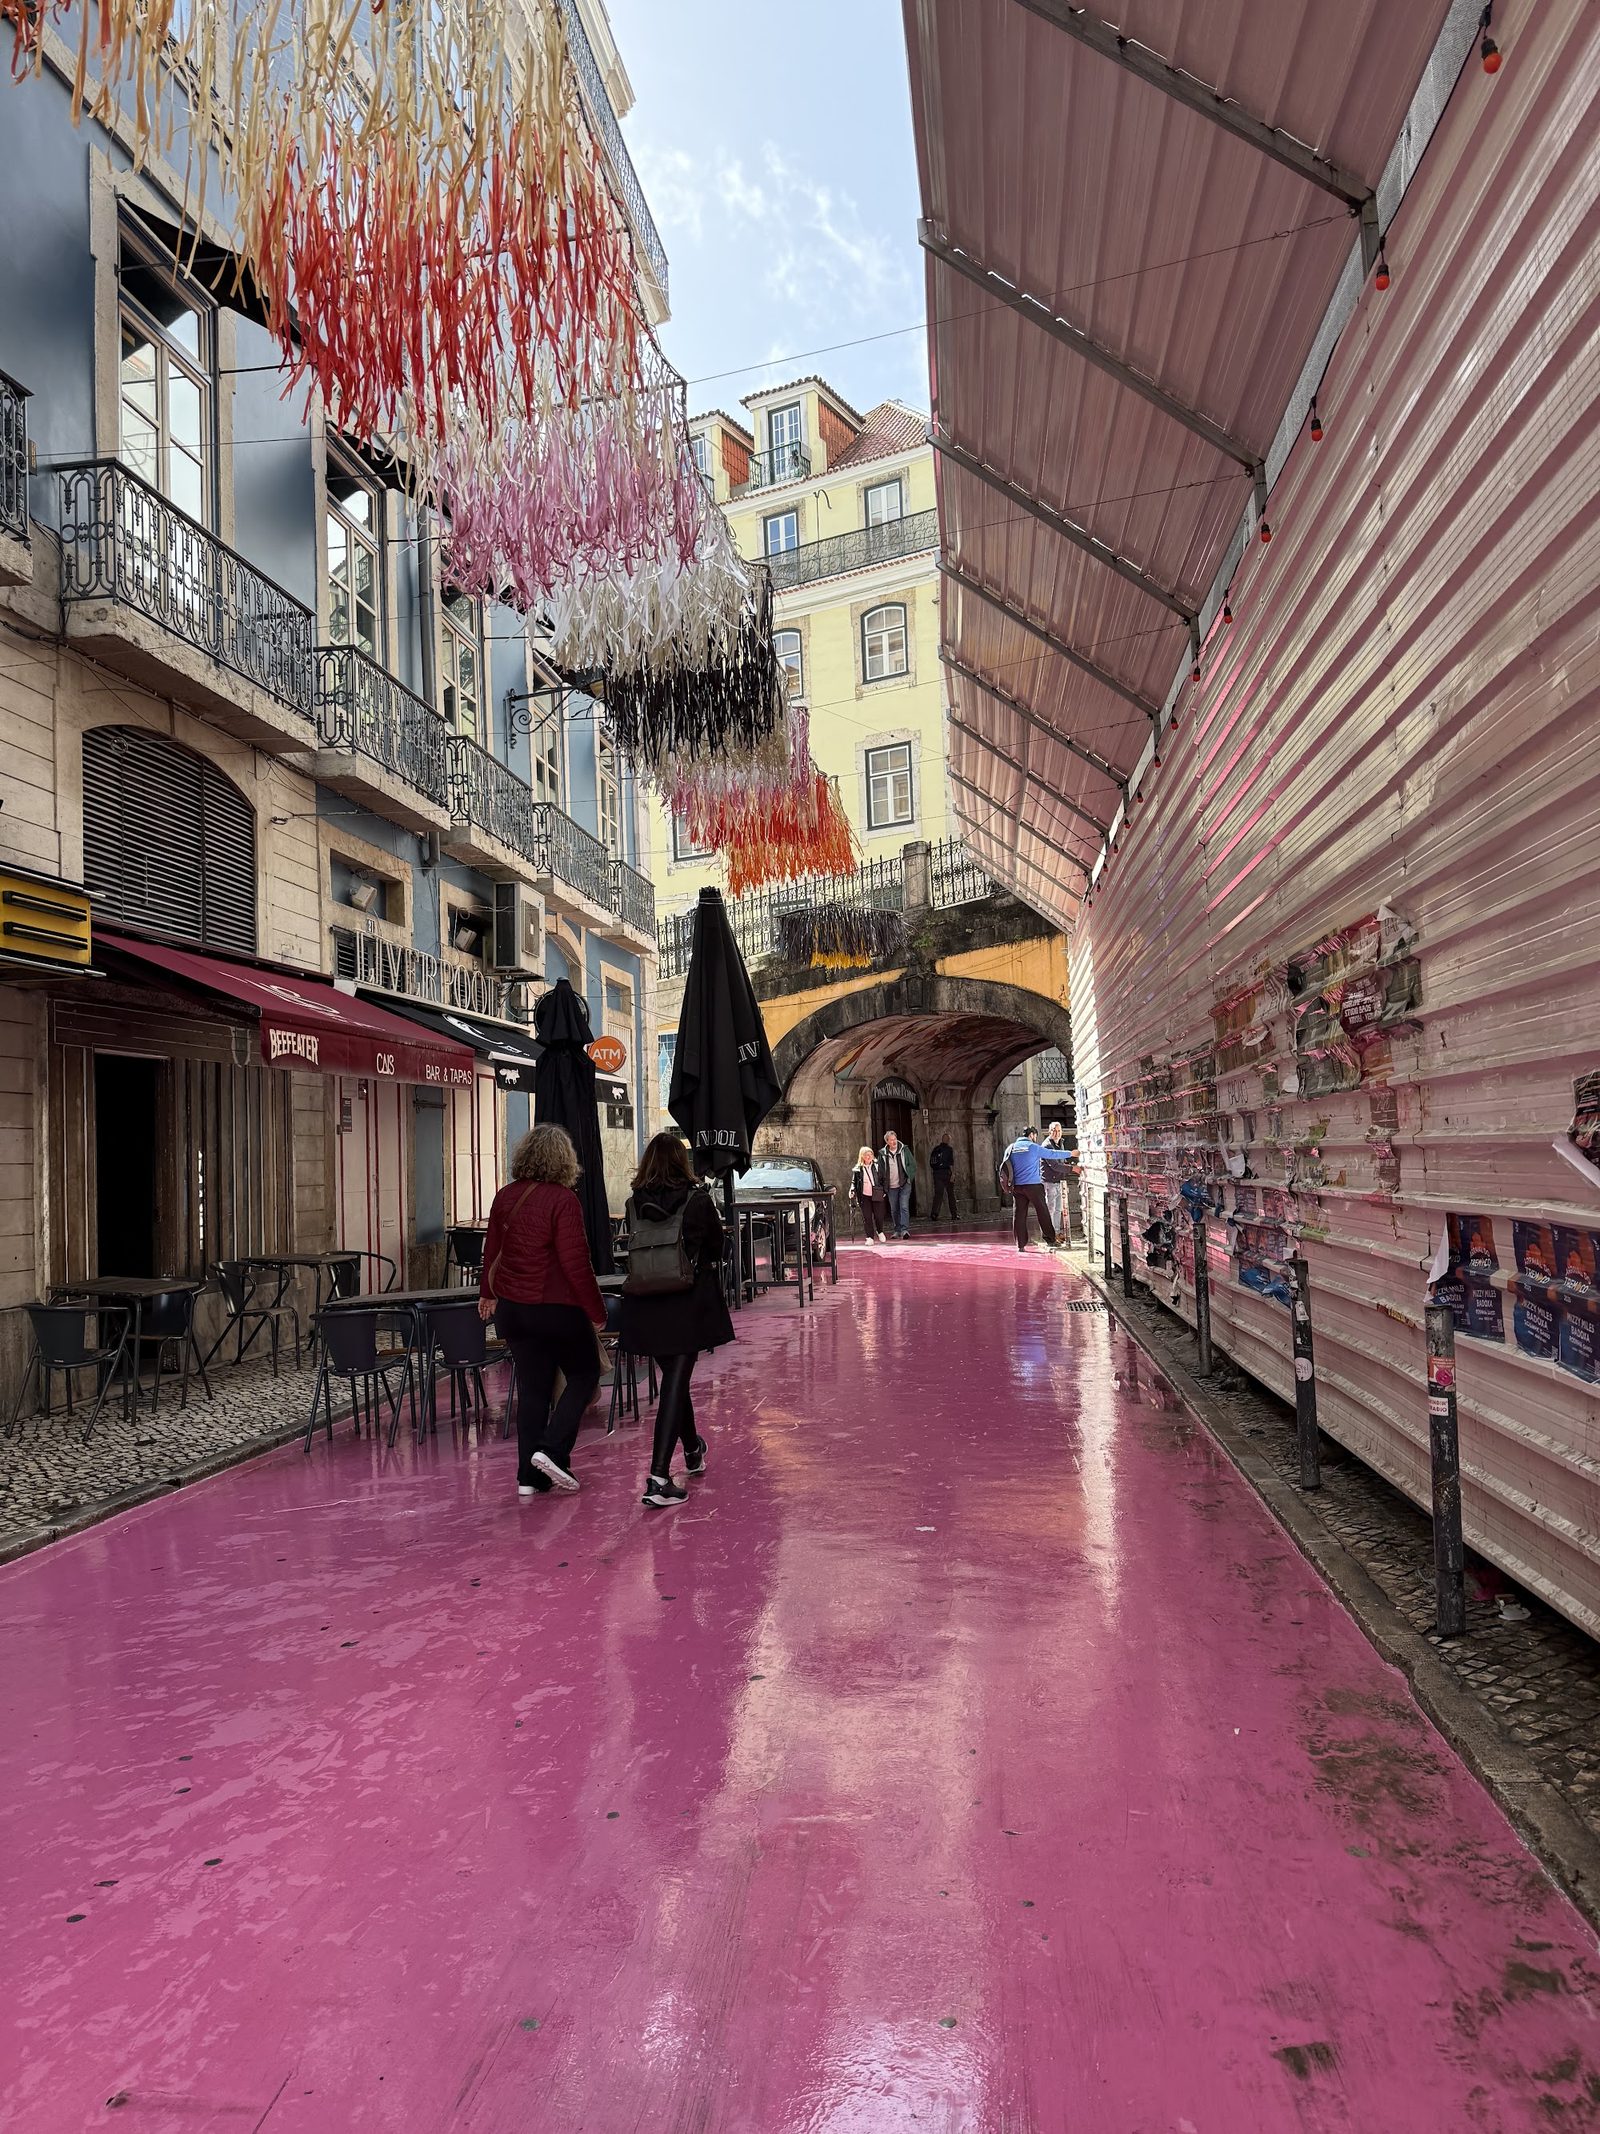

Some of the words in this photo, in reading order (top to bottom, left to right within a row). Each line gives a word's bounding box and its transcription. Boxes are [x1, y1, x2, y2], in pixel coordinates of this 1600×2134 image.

[354, 928, 500, 1019] LIVERPOOL
[269, 1028, 319, 1066] BEEFEATER
[592, 1048, 621, 1060] ATM
[425, 1064, 440, 1081] BAR
[443, 1067, 449, 1082] &
[450, 1068, 472, 1085] TAPAS
